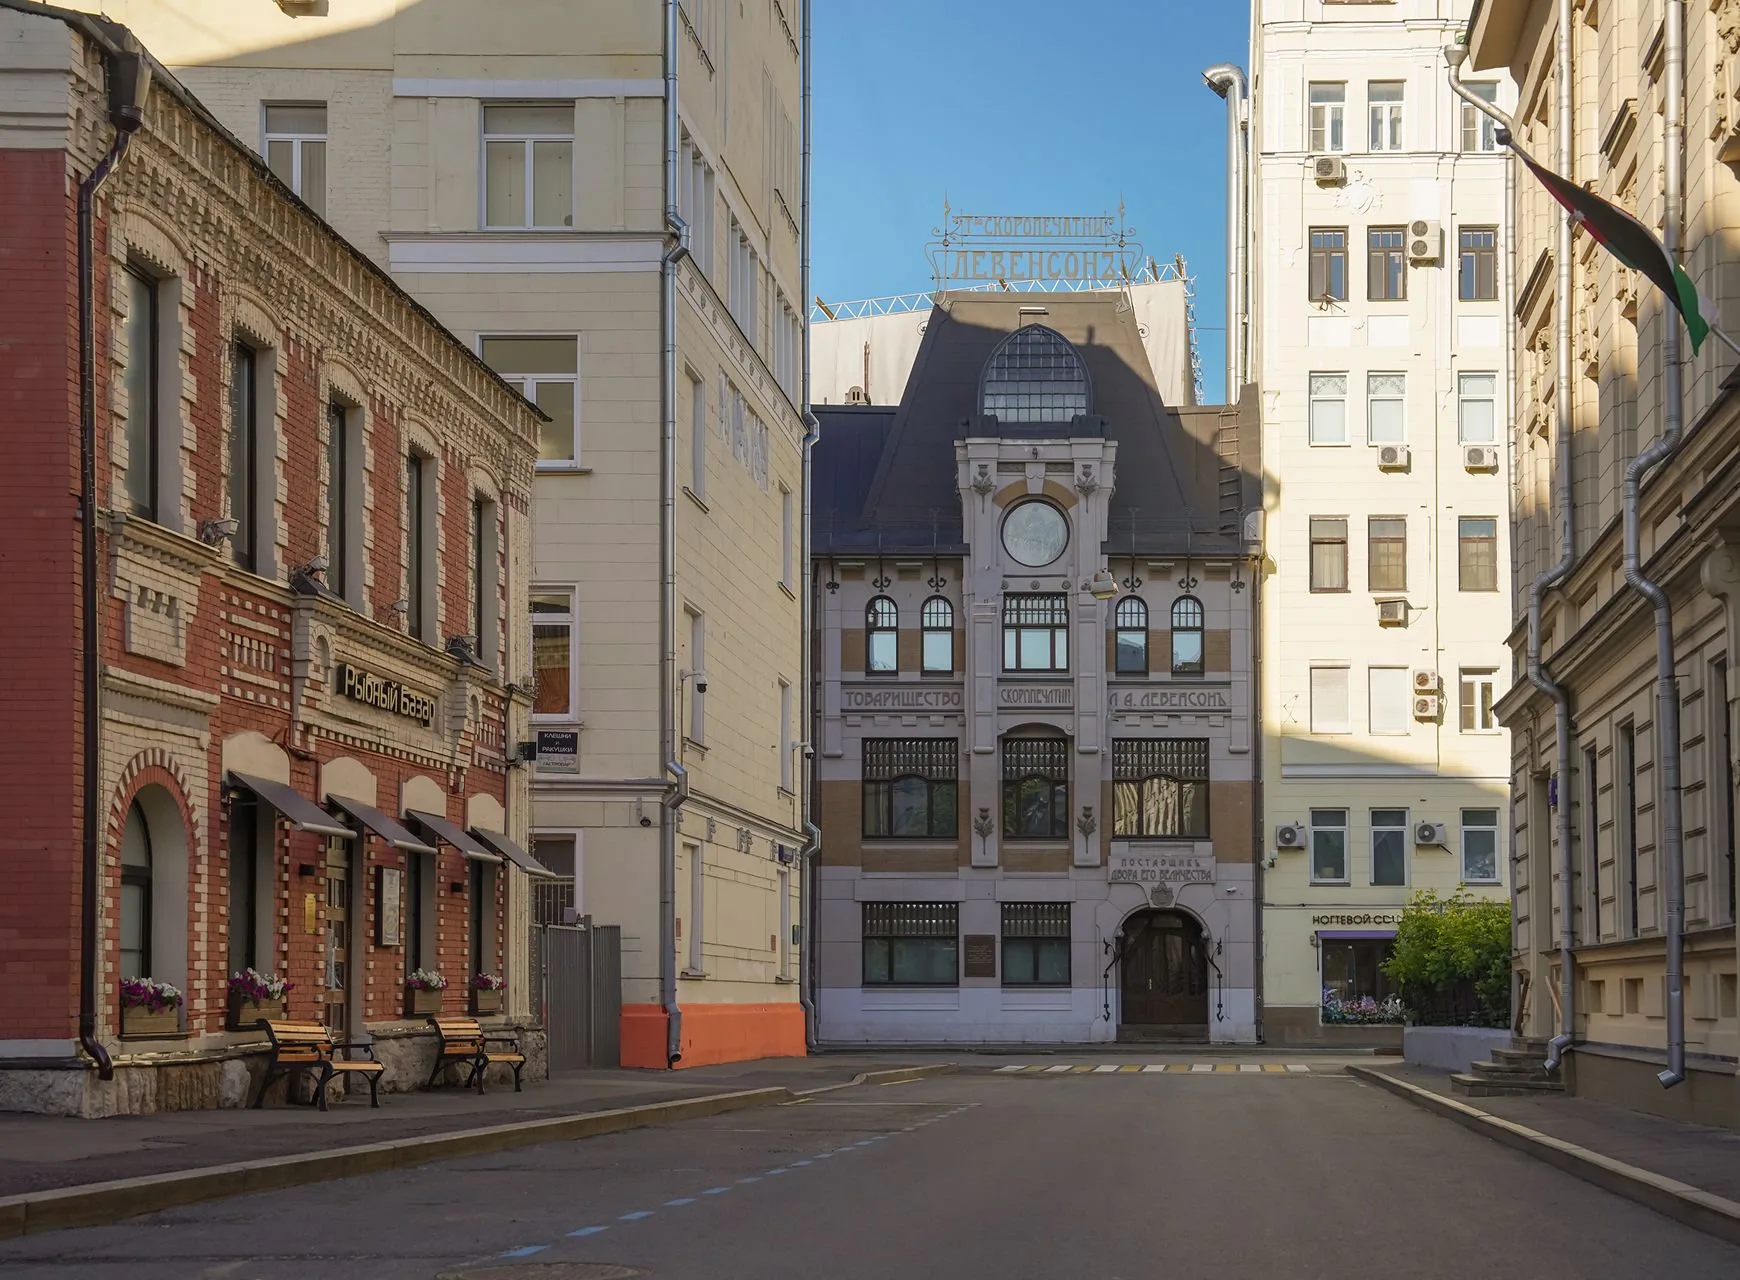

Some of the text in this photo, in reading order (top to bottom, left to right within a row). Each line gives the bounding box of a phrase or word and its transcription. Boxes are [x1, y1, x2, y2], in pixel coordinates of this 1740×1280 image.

[984, 217, 1103, 236] СКОРОПЕЧАТНИ
[345, 664, 436, 728] Рыбный Базар
[845, 691, 961, 707] ТОВАРИЩЕСТВО
[1111, 869, 1212, 881] ДВОРА ЕГО ВЕЛИЧЕСТВА
[1312, 913, 1371, 925] НОГТЕВОЙ
